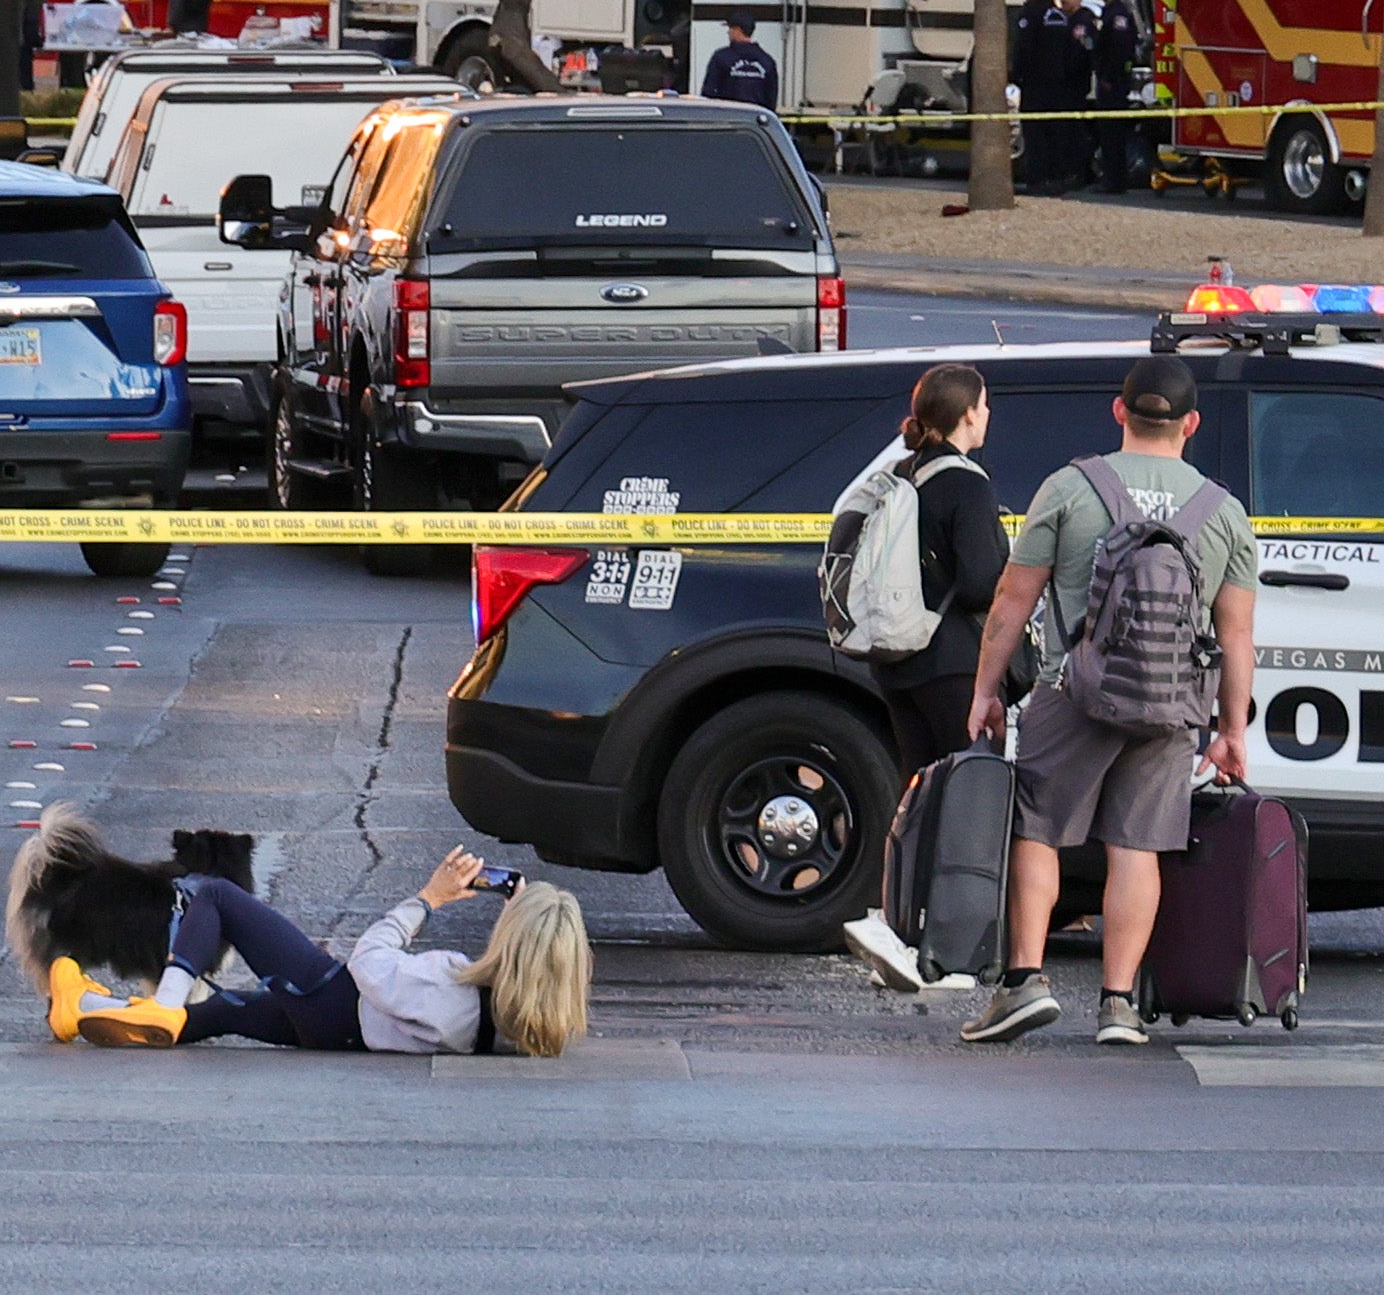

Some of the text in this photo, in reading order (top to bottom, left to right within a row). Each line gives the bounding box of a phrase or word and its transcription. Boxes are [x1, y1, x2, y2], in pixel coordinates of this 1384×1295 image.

[575, 214, 667, 226] LEGEND
[462, 326, 786, 343] SUPER DUTY
[620, 477, 669, 492] CRIME
[603, 490, 680, 507] STOPPERS
[19, 516, 51, 526] CROSS
[61, 516, 90, 526] CRIME
[95, 516, 124, 526] SCENE
[169, 517, 377, 528] POLICE LINE DO NOT CROSS CRIME SCENE
[423, 519, 627, 528] POLICE LINE DO NOT CROSS CRIME SCENE
[672, 519, 830, 530] POLICE LINE DO NOT CROSS CRI
[597, 550, 629, 562] DIAL
[644, 554, 676, 563] DIAL
[1262, 543, 1379, 564] TACTICAL
[590, 585, 622, 595] NON
[1254, 649, 1345, 669] VEGAS
